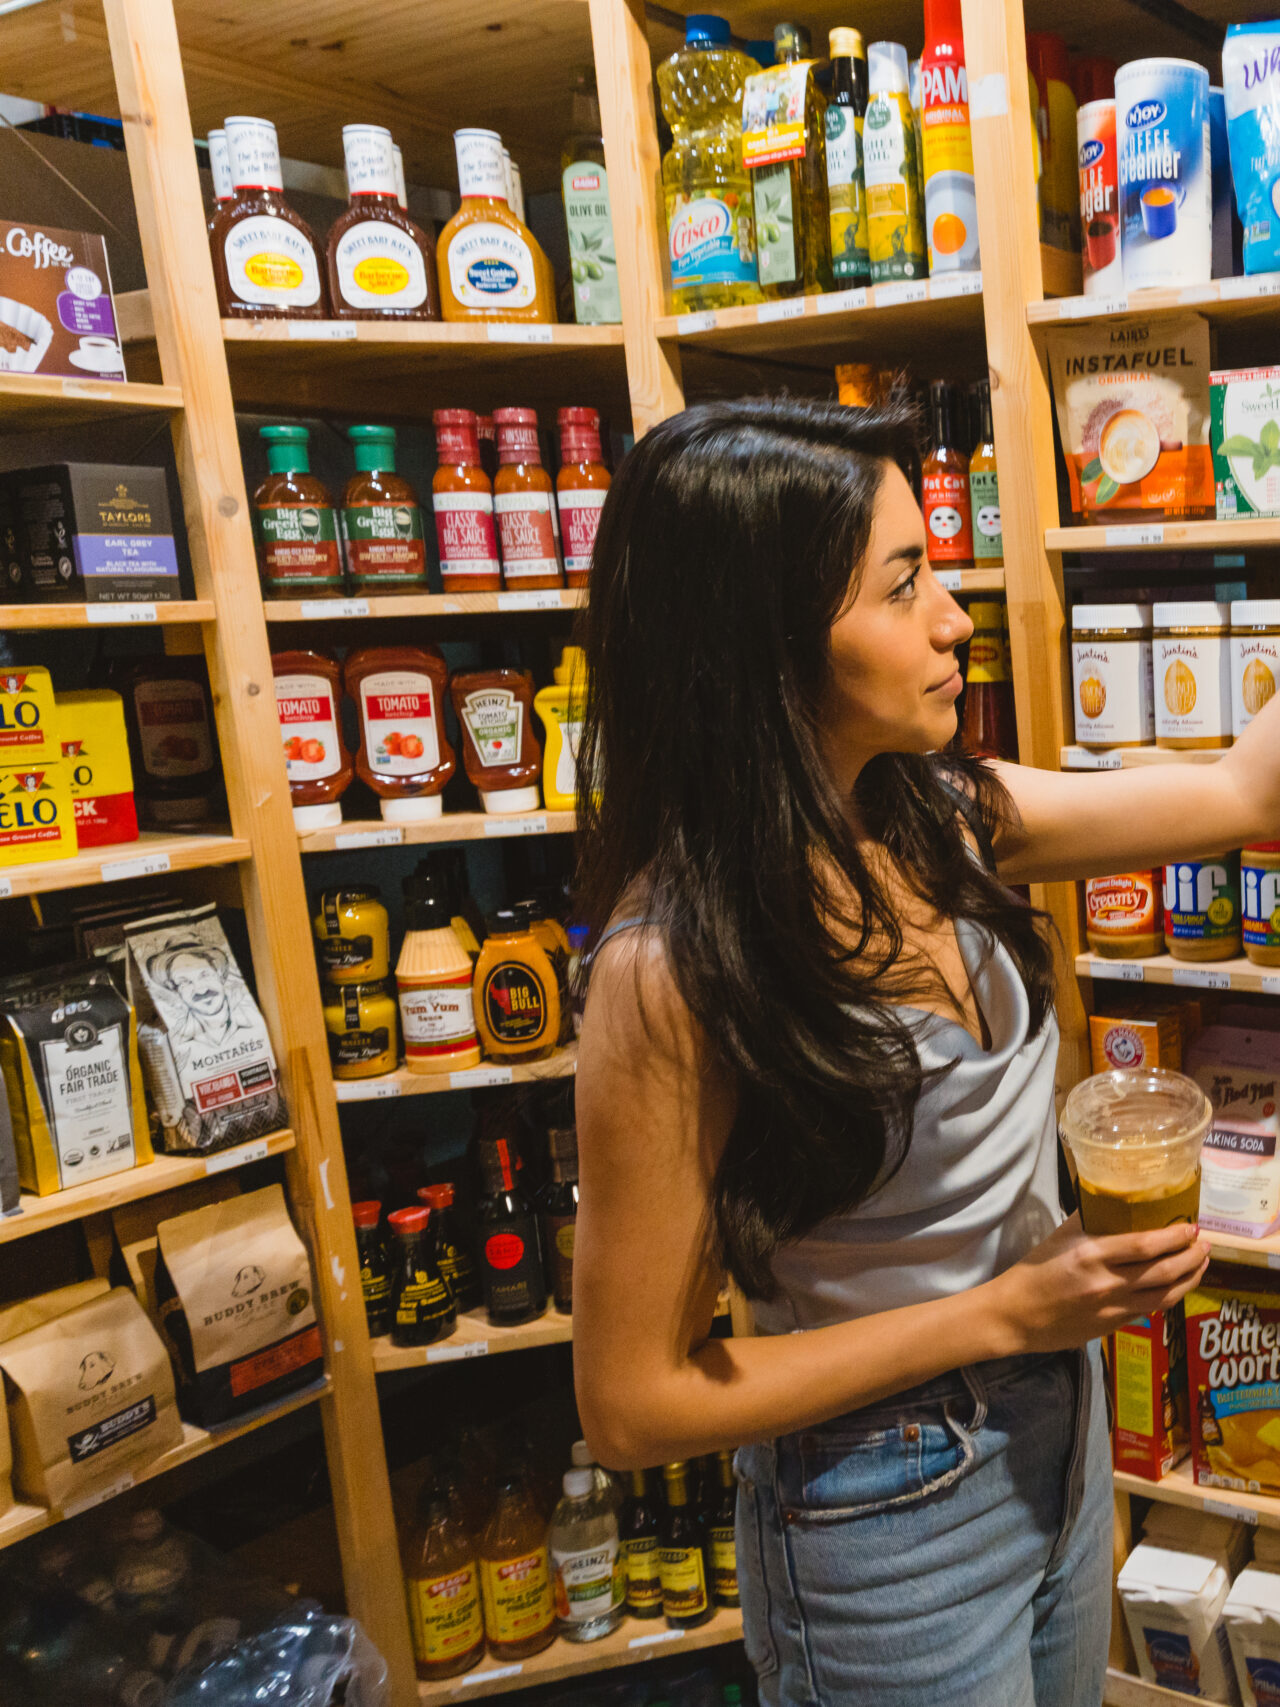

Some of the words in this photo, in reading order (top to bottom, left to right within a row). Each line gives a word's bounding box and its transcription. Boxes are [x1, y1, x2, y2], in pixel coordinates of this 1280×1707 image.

[922, 66, 967, 103] PAM
[1121, 151, 1181, 185] creamer
[570, 204, 592, 216] OLIVE
[595, 204, 607, 215] OIL
[674, 215, 720, 258] Crisco
[6, 228, 73, 268] Coffee
[1066, 348, 1193, 376] INSTAFUEL
[1099, 373, 1150, 385] ORIGINAL
[276, 508, 298, 522] Big
[372, 506, 393, 519] Big
[445, 512, 478, 528] CLASSIC
[263, 518, 299, 530] Green
[357, 516, 394, 528] Green
[276, 528, 300, 540] Egg
[371, 526, 395, 538] Egg
[462, 526, 487, 544] SAUCE
[105, 539, 128, 548] EARL
[131, 539, 152, 548] GREY
[122, 548, 139, 557] TEA
[1161, 643, 1199, 659] Justin's
[1240, 642, 1279, 658] Justin's
[377, 696, 420, 712] TOMATO
[474, 699, 505, 709] HEINZ
[1163, 865, 1227, 912] Jif
[1090, 891, 1141, 911] Creamy
[509, 987, 529, 1000] BIG
[432, 1002, 459, 1013] Yum
[510, 996, 540, 1011] BULL
[65, 1059, 111, 1081] ORGANIC
[59, 1079, 84, 1095] FAIR
[87, 1070, 119, 1087] TRADE
[202, 1298, 253, 1327] BUDDY
[259, 1280, 301, 1304] BREW
[1219, 1300, 1259, 1323] Mrs.
